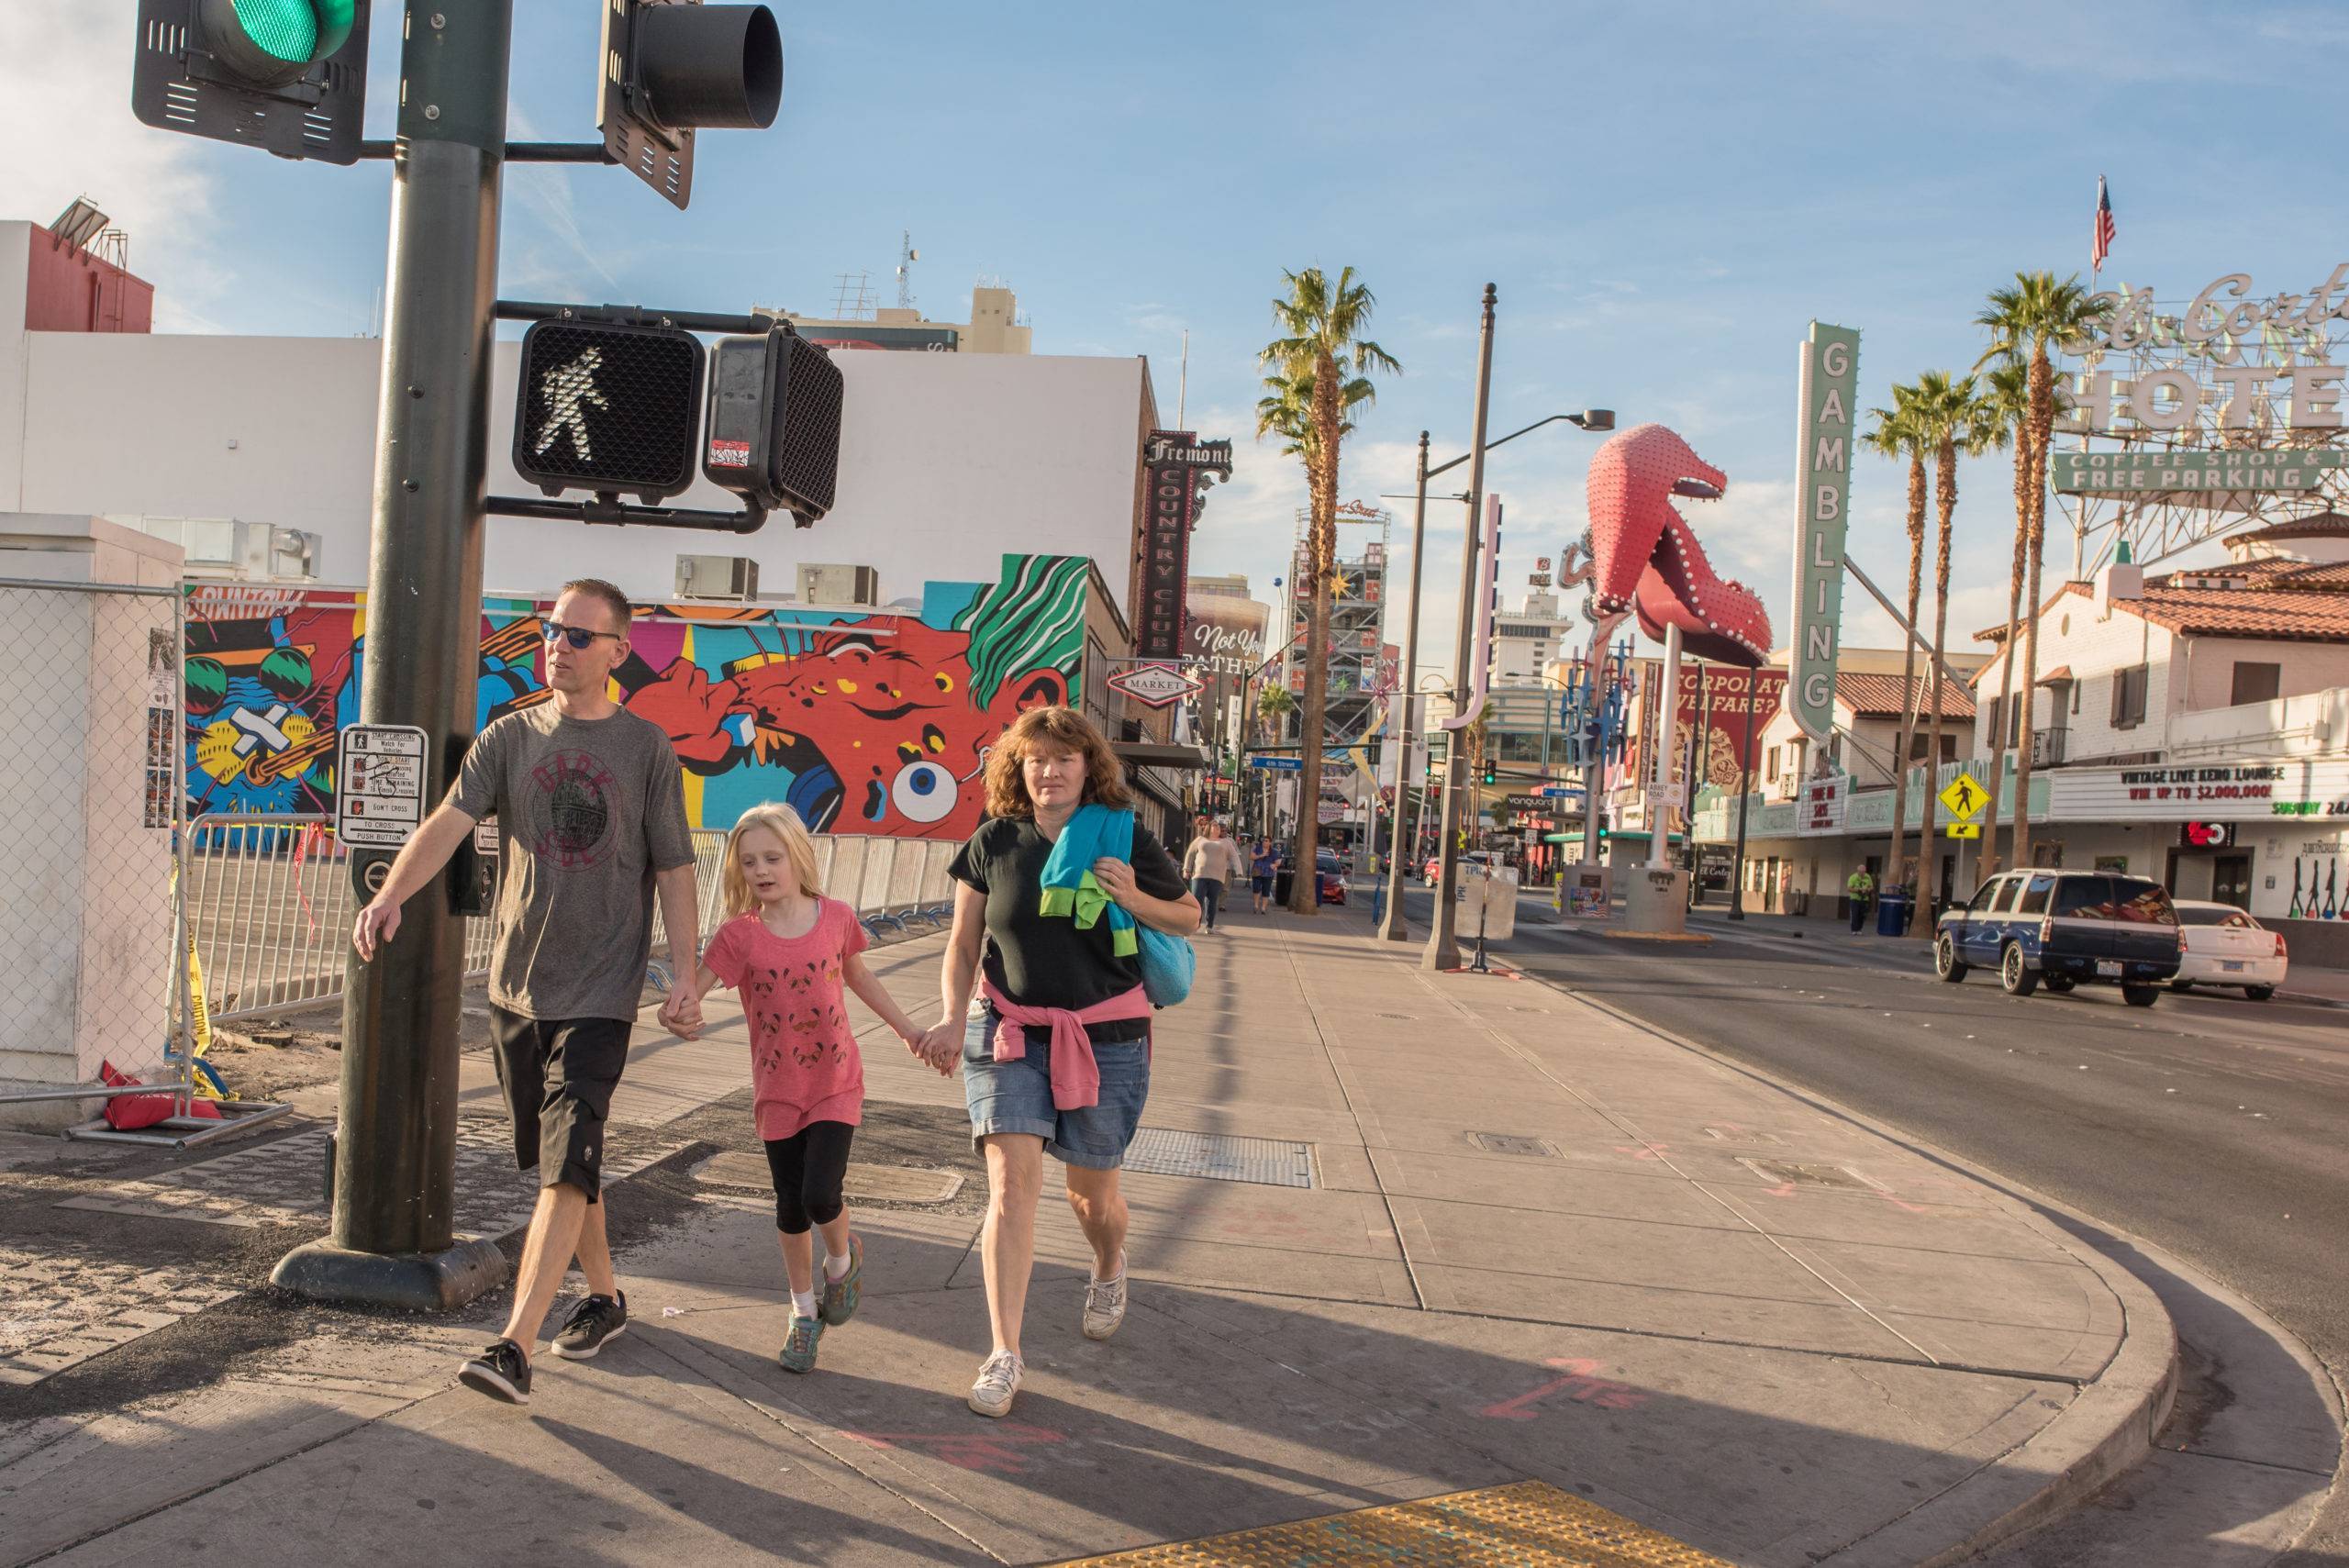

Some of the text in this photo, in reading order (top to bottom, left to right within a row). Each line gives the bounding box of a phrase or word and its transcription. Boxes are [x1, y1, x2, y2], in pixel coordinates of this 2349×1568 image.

[1147, 435, 1231, 463] Fremont
[2069, 453, 2188, 468] COFFEE
[2204, 452, 2288, 467] SHOP
[2302, 451, 2322, 466] &
[2072, 468, 2300, 488] FREE PARKING
[1154, 469, 1182, 577] COUNTRY
[1802, 340, 1850, 710] GAMBLING
[1151, 589, 1175, 650] CLUB
[1195, 624, 1237, 653] Not
[1130, 679, 1183, 690] MARKET
[530, 753, 615, 797] DARK
[2121, 766, 2285, 785] VINTAGE LIVE KENO LOUNGE
[1508, 797, 1553, 807] vanguard
[1649, 790, 1664, 798] ROAD
[2129, 786, 2151, 801] WIN
[2156, 786, 2172, 800] UP
[2176, 786, 2192, 800] TO
[391, 805, 408, 813] CROSS
[364, 820, 395, 829] TO CROSS
[357, 832, 401, 841] PUSH BUTTON
[191, 995, 207, 1036] CAUTION
